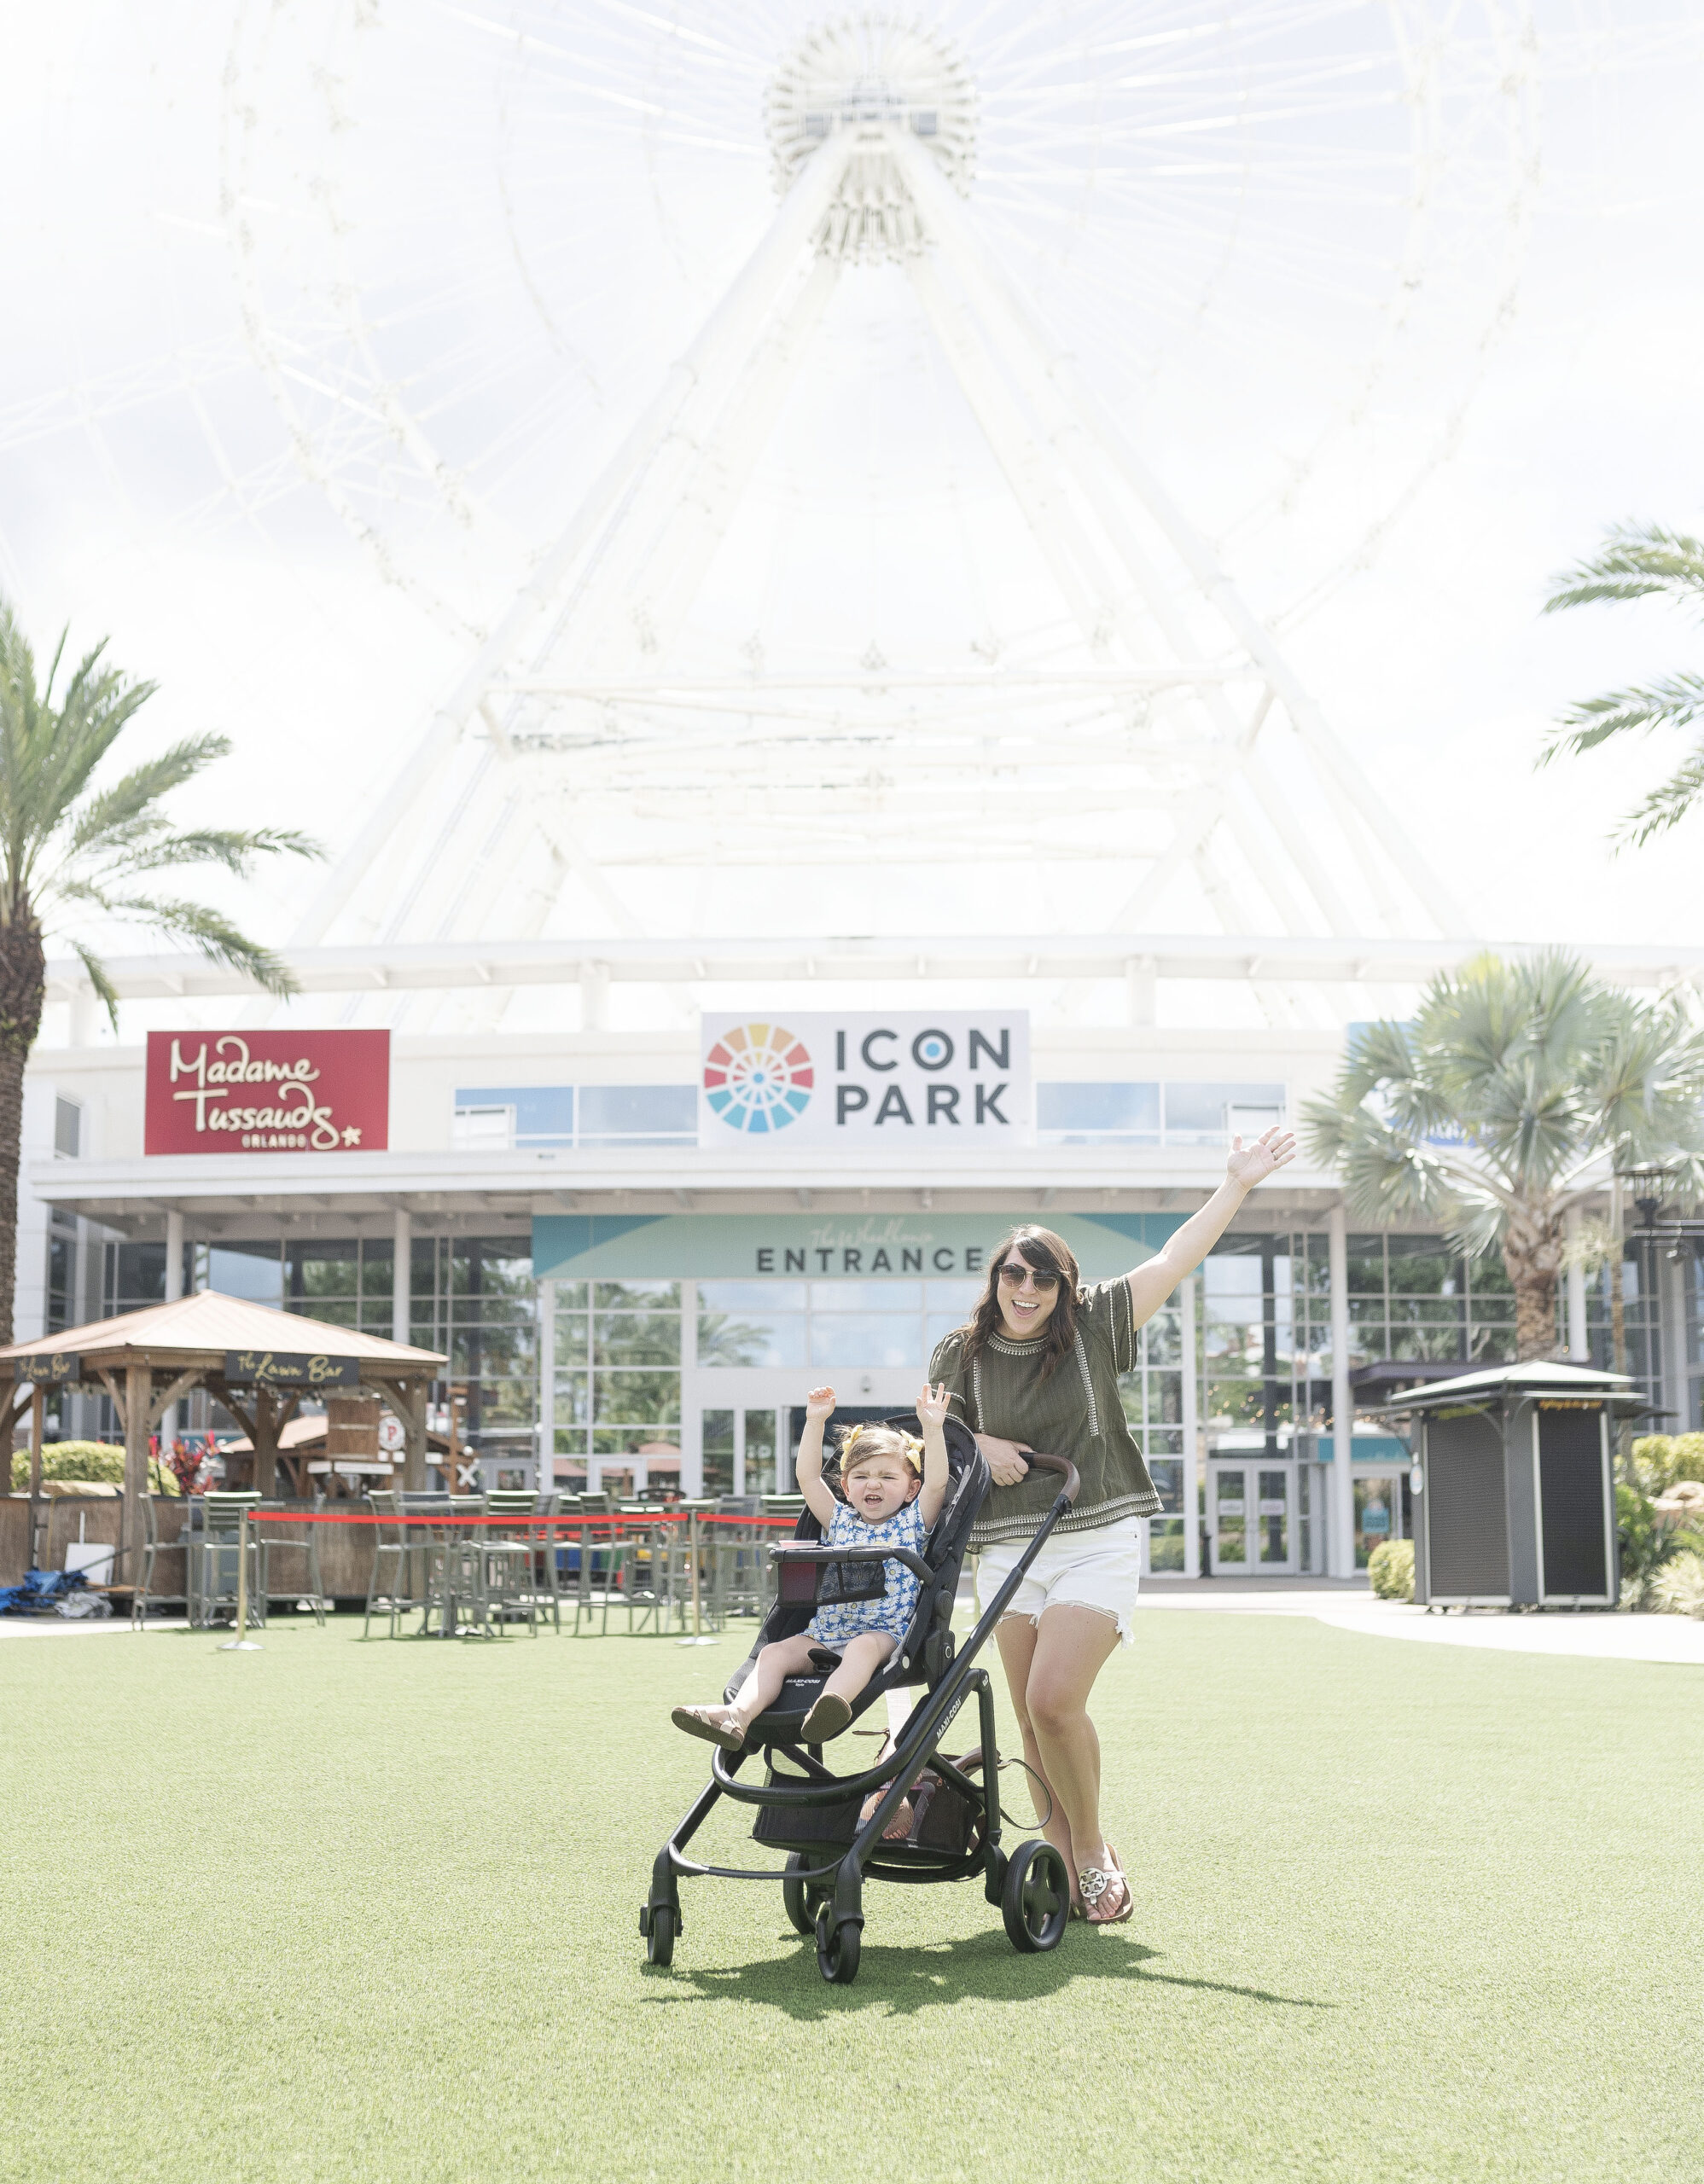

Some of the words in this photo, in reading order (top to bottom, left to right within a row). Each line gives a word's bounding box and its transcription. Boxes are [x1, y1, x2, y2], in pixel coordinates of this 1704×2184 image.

[170, 1035, 321, 1089] Madame
[835, 1029, 1010, 1072] ICON
[172, 1080, 340, 1150] Tussauds
[835, 1083, 1010, 1126] PARK
[241, 1134, 306, 1148] ORLANDO
[756, 1247, 983, 1273] ENTRANCE
[255, 1353, 304, 1381] Lawn
[307, 1355, 344, 1383] Bar
[387, 1426, 398, 1441] P
